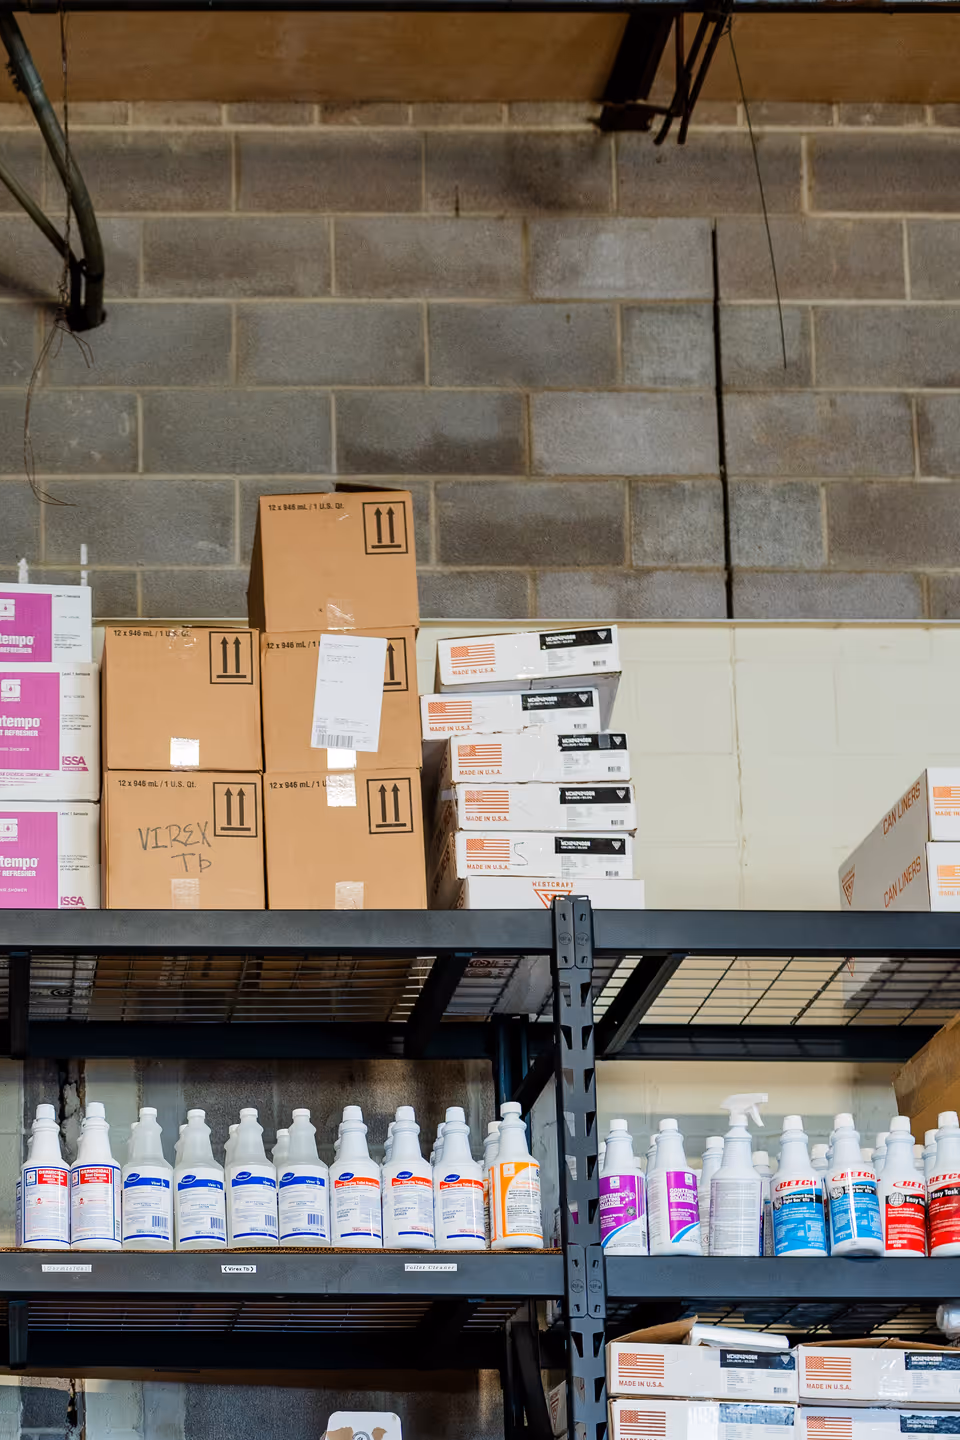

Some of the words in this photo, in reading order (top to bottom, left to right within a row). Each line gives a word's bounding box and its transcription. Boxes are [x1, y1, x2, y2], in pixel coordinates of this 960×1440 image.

[0, 646, 32, 654] REFRESHER
[62, 756, 86, 766] ISSA
[883, 808, 896, 835] CAN
[898, 782, 920, 819] LINERS
[138, 821, 212, 850] VIREX
[171, 853, 212, 873] Tb
[884, 882, 897, 908] CAN
[899, 856, 922, 892] LINERS
[60, 896, 85, 906] ISSA
[780, 1180, 816, 1188] BETCO
[906, 1196, 918, 1204] Easy
